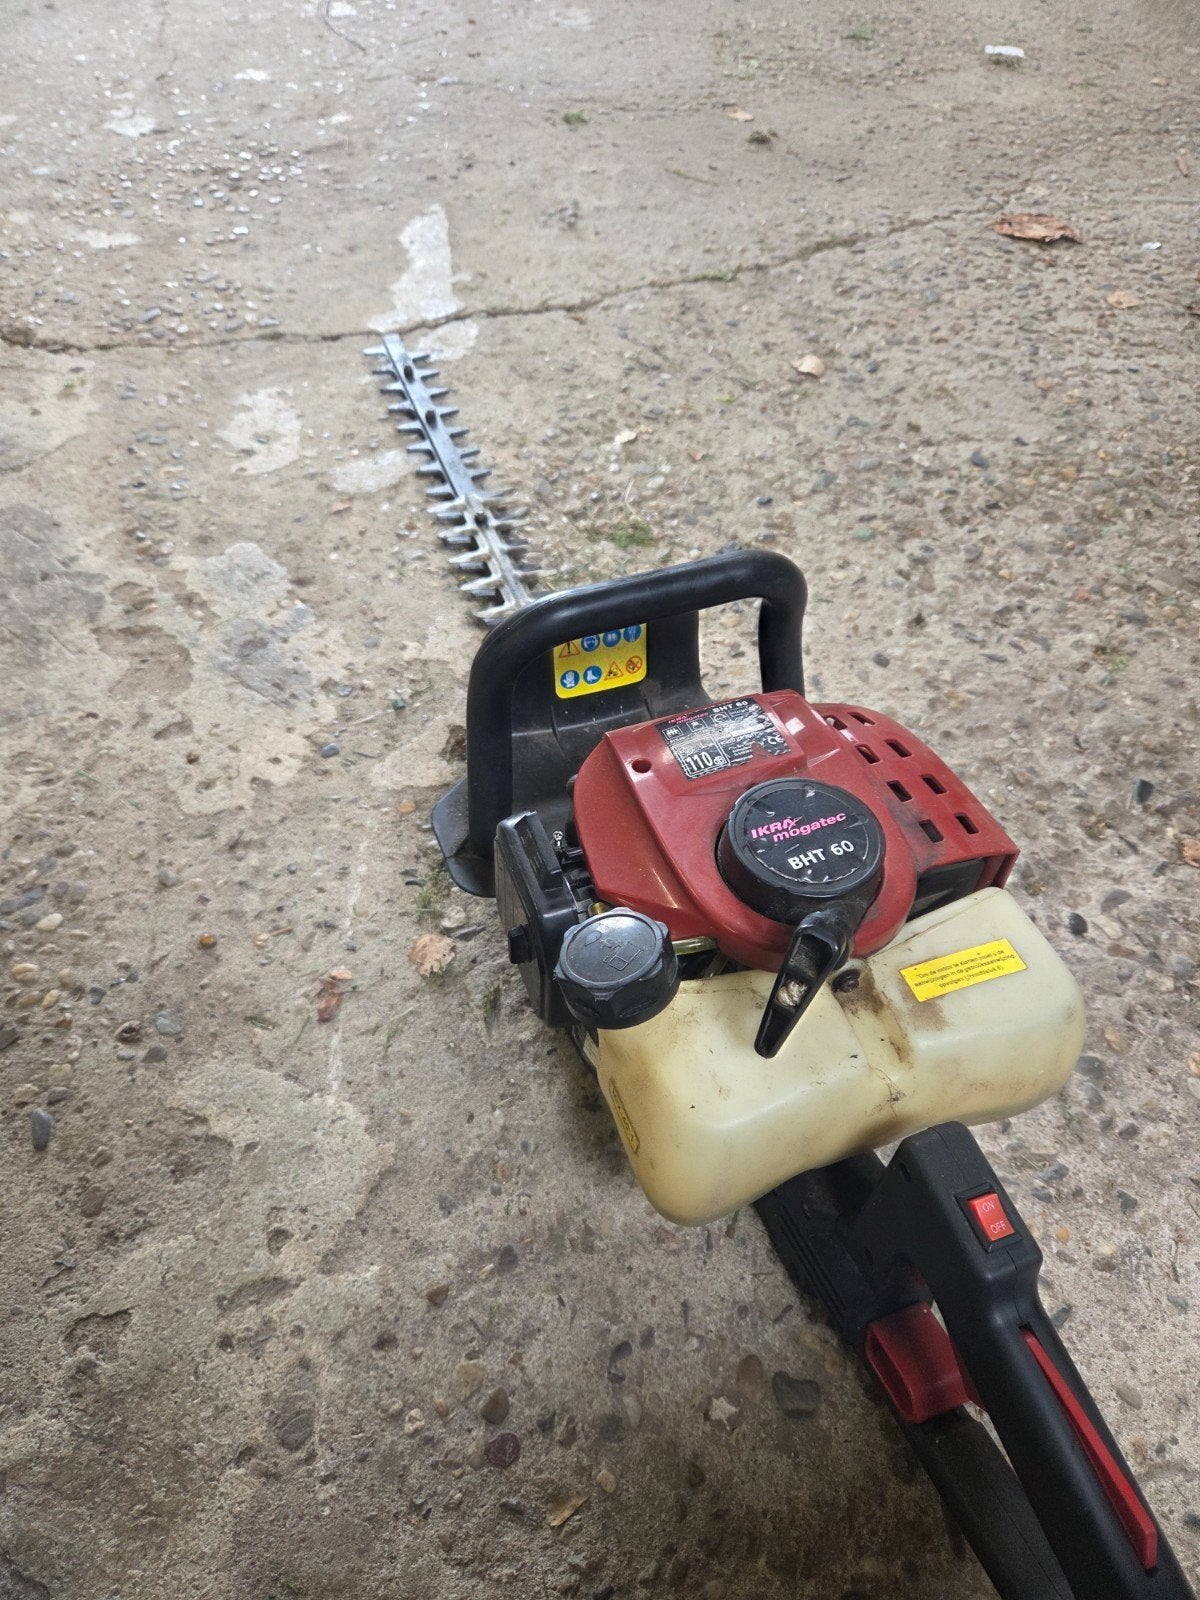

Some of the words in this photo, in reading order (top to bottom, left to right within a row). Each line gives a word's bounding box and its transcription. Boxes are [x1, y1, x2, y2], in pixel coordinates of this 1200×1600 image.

[712, 704, 733, 713] BHT
[685, 751, 713, 771] 110
[751, 817, 802, 838] IKRA
[772, 813, 847, 842] mogatec
[787, 848, 826, 870] BHT
[830, 840, 855, 856] 60
[982, 1201, 995, 1212] ON
[990, 1220, 1006, 1234] OFF
